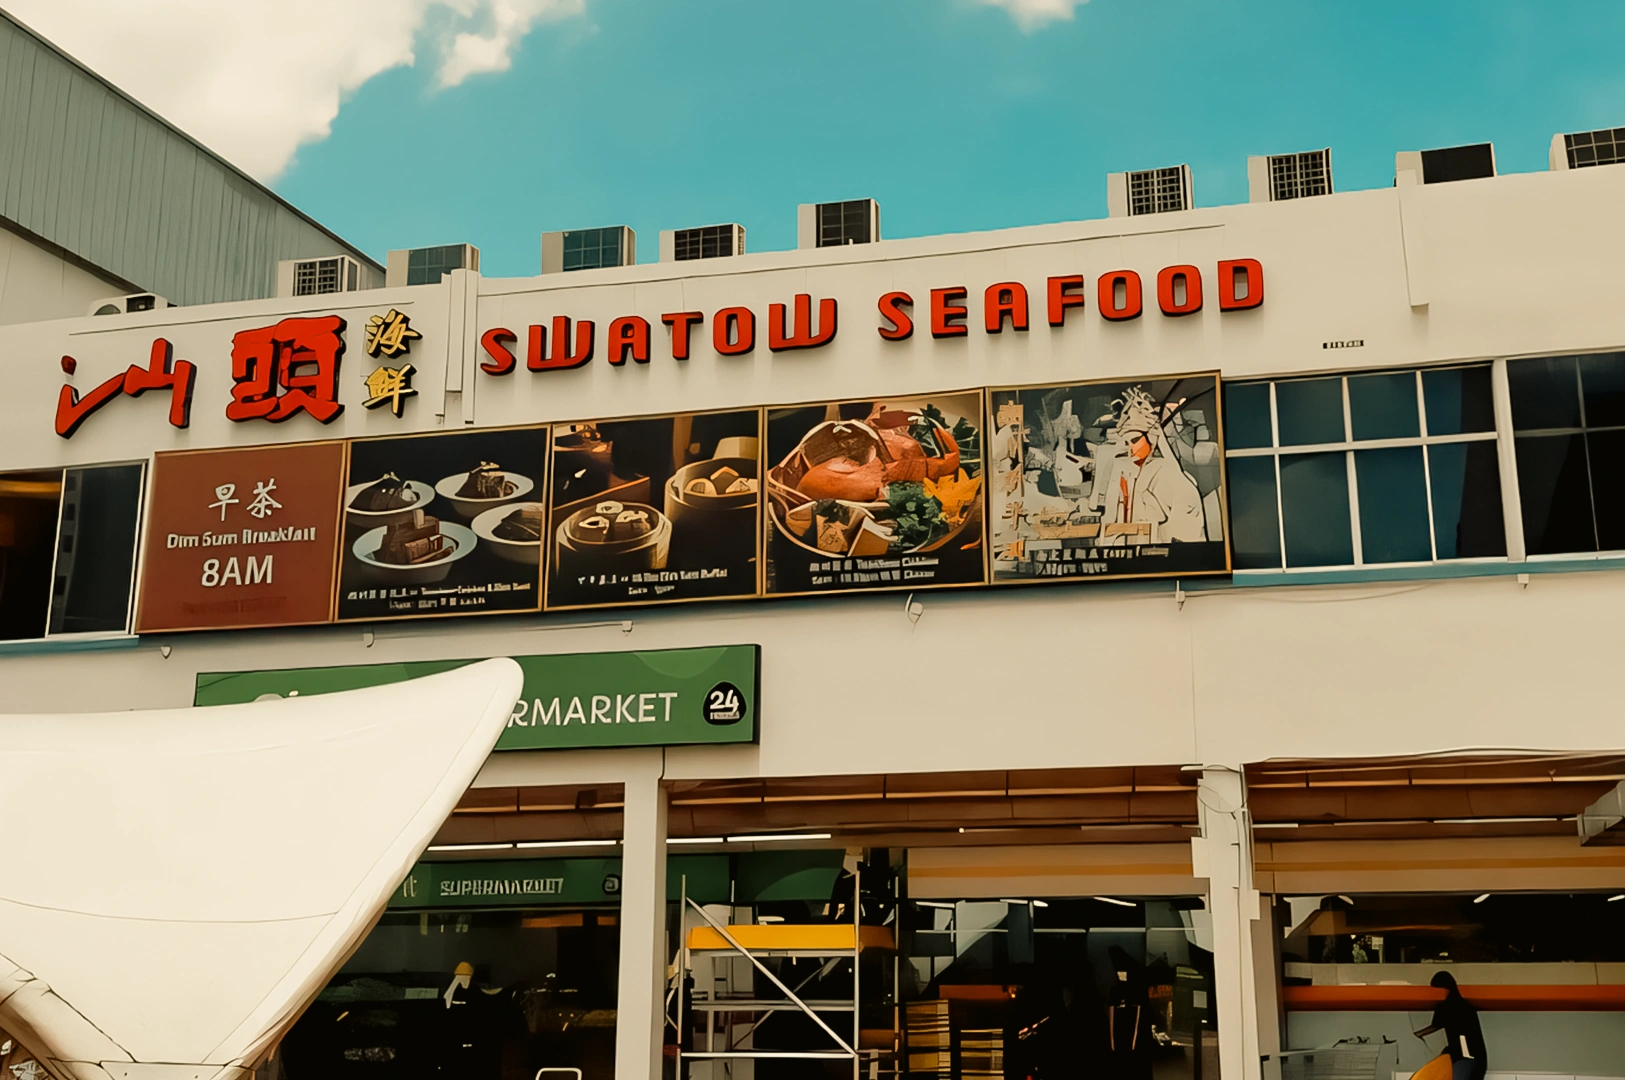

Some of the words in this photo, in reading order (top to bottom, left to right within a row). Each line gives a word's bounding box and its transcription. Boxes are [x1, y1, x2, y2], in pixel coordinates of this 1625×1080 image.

[480, 293, 838, 376] SWATOW
[877, 257, 1264, 341] SEAFOOD
[208, 477, 283, 522] 早茶
[201, 554, 274, 588] 8AM
[709, 689, 740, 714] 24
